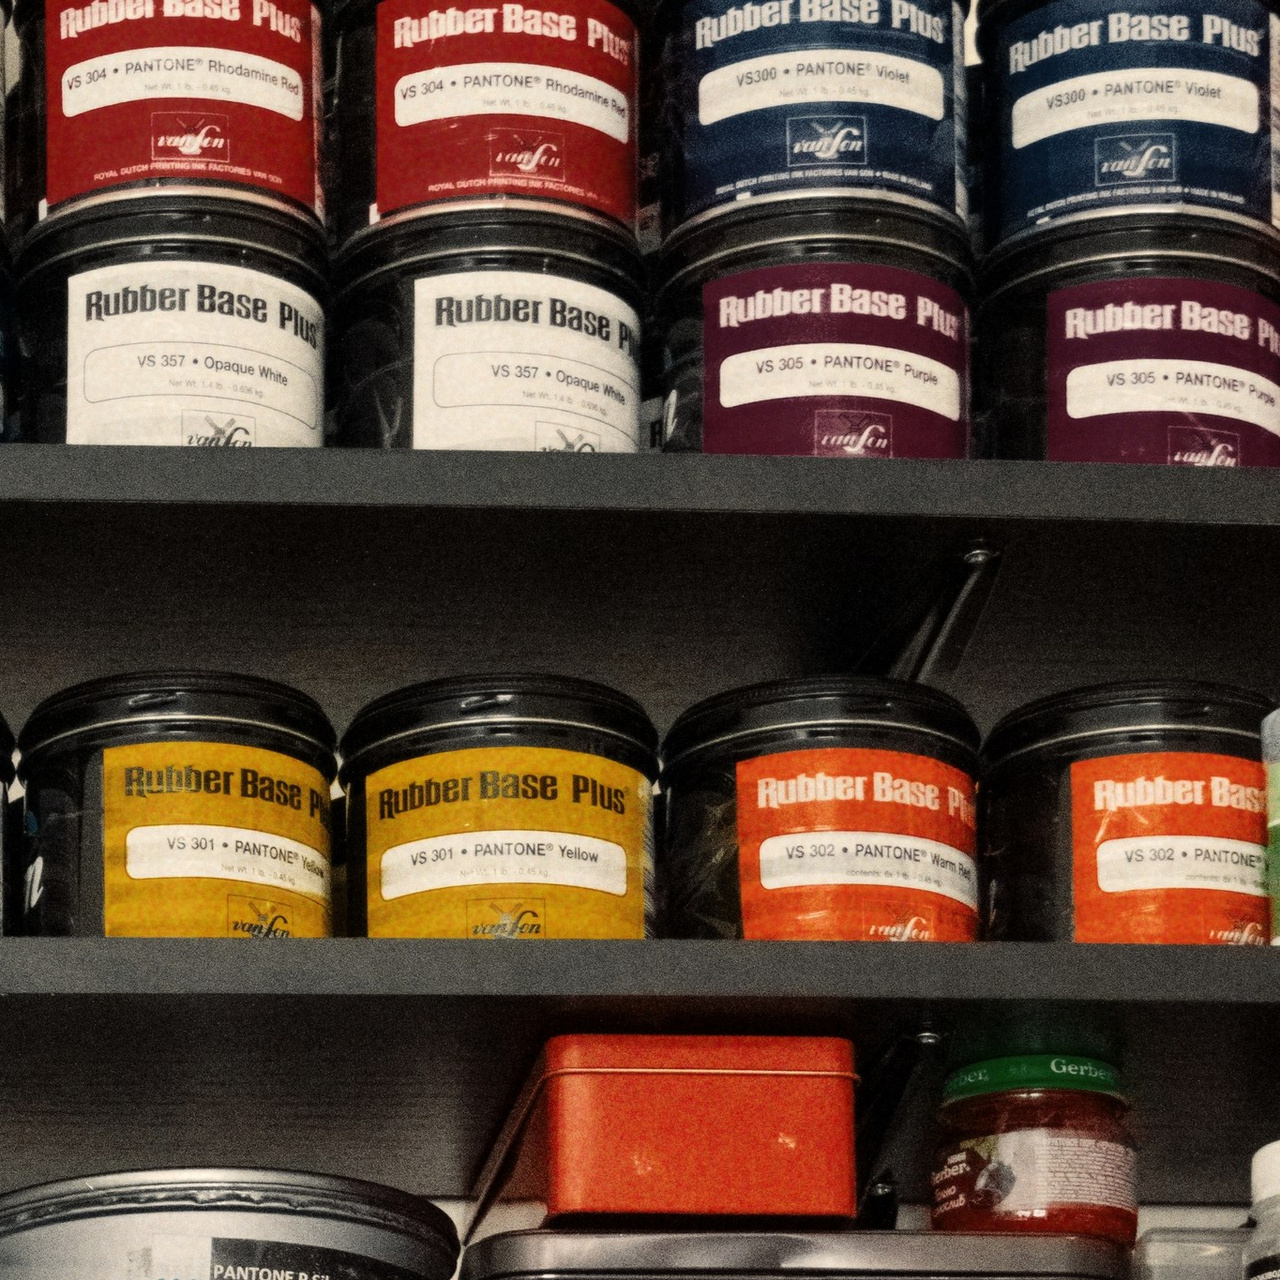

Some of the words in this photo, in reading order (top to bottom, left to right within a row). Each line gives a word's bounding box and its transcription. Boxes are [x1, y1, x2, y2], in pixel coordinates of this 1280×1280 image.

[253, 1, 301, 42] Plus
[394, 7, 497, 49] Rubber
[503, 4, 576, 41] Base
[1010, 20, 1102, 74] Rubber
[1108, 13, 1189, 43] Base
[67, 76, 82, 90] VS
[86, 68, 107, 85] 304
[208, 59, 277, 86] Rhodamine
[280, 77, 299, 96] Red
[736, 67, 777, 86] VS300
[877, 66, 910, 85] Violet
[420, 79, 443, 95] 304
[546, 77, 609, 108] Rhodamine
[1185, 82, 1221, 100] Violet
[86, 285, 189, 322] Rubber
[197, 284, 267, 323] Base
[138, 355, 156, 368] VS
[161, 355, 184, 367] 357
[204, 356, 254, 377] Opaque
[257, 364, 288, 385] White
[515, 366, 538, 379] 357
[557, 369, 599, 395] Opaque
[779, 357, 802, 370] 305
[904, 364, 937, 385] Purple
[1131, 373, 1155, 384] 305
[167, 838, 186, 850] VS
[191, 838, 215, 850] 301
[411, 854, 429, 867] VS
[431, 847, 454, 863] 301
[559, 845, 599, 864] Yellow
[810, 844, 835, 858] 302
[931, 852, 955, 872] Warm
[1149, 849, 1174, 860] 302
